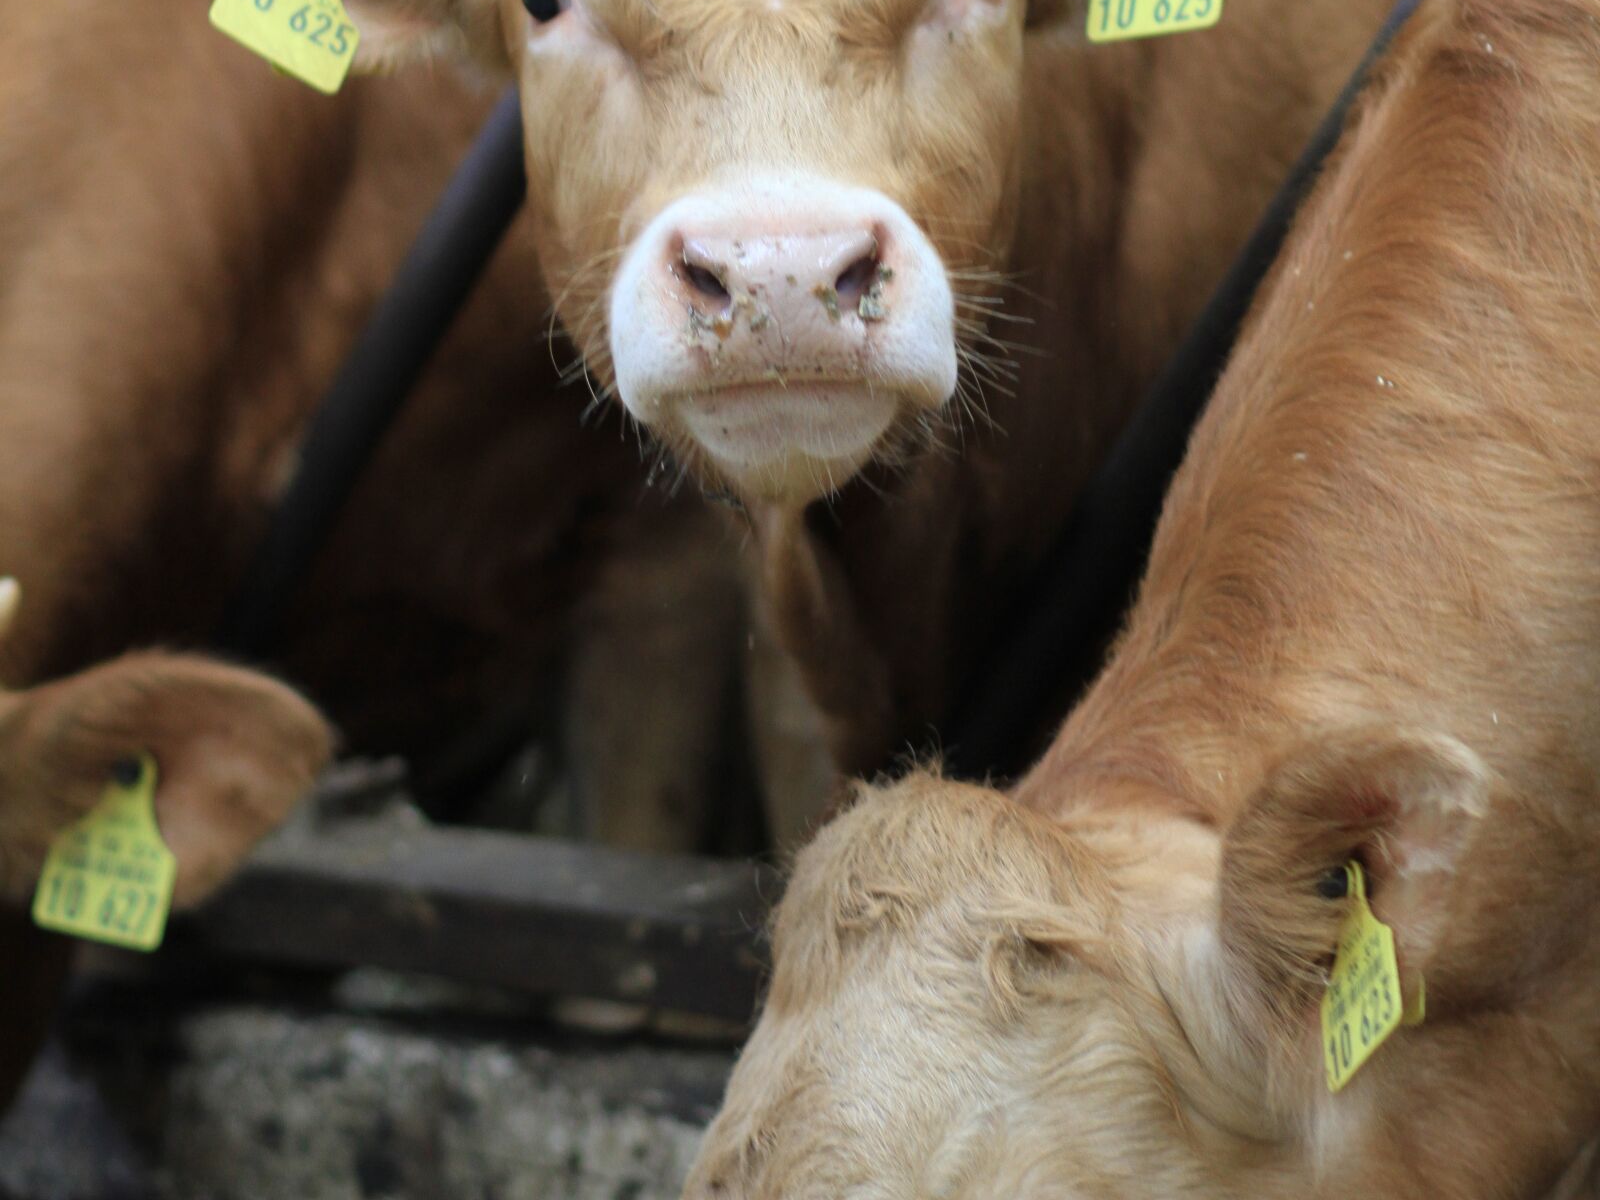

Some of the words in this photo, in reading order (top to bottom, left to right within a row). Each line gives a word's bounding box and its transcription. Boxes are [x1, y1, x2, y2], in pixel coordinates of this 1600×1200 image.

[288, 5, 355, 56] 625
[48, 875, 86, 919] 10
[1329, 1022, 1351, 1079] 10
